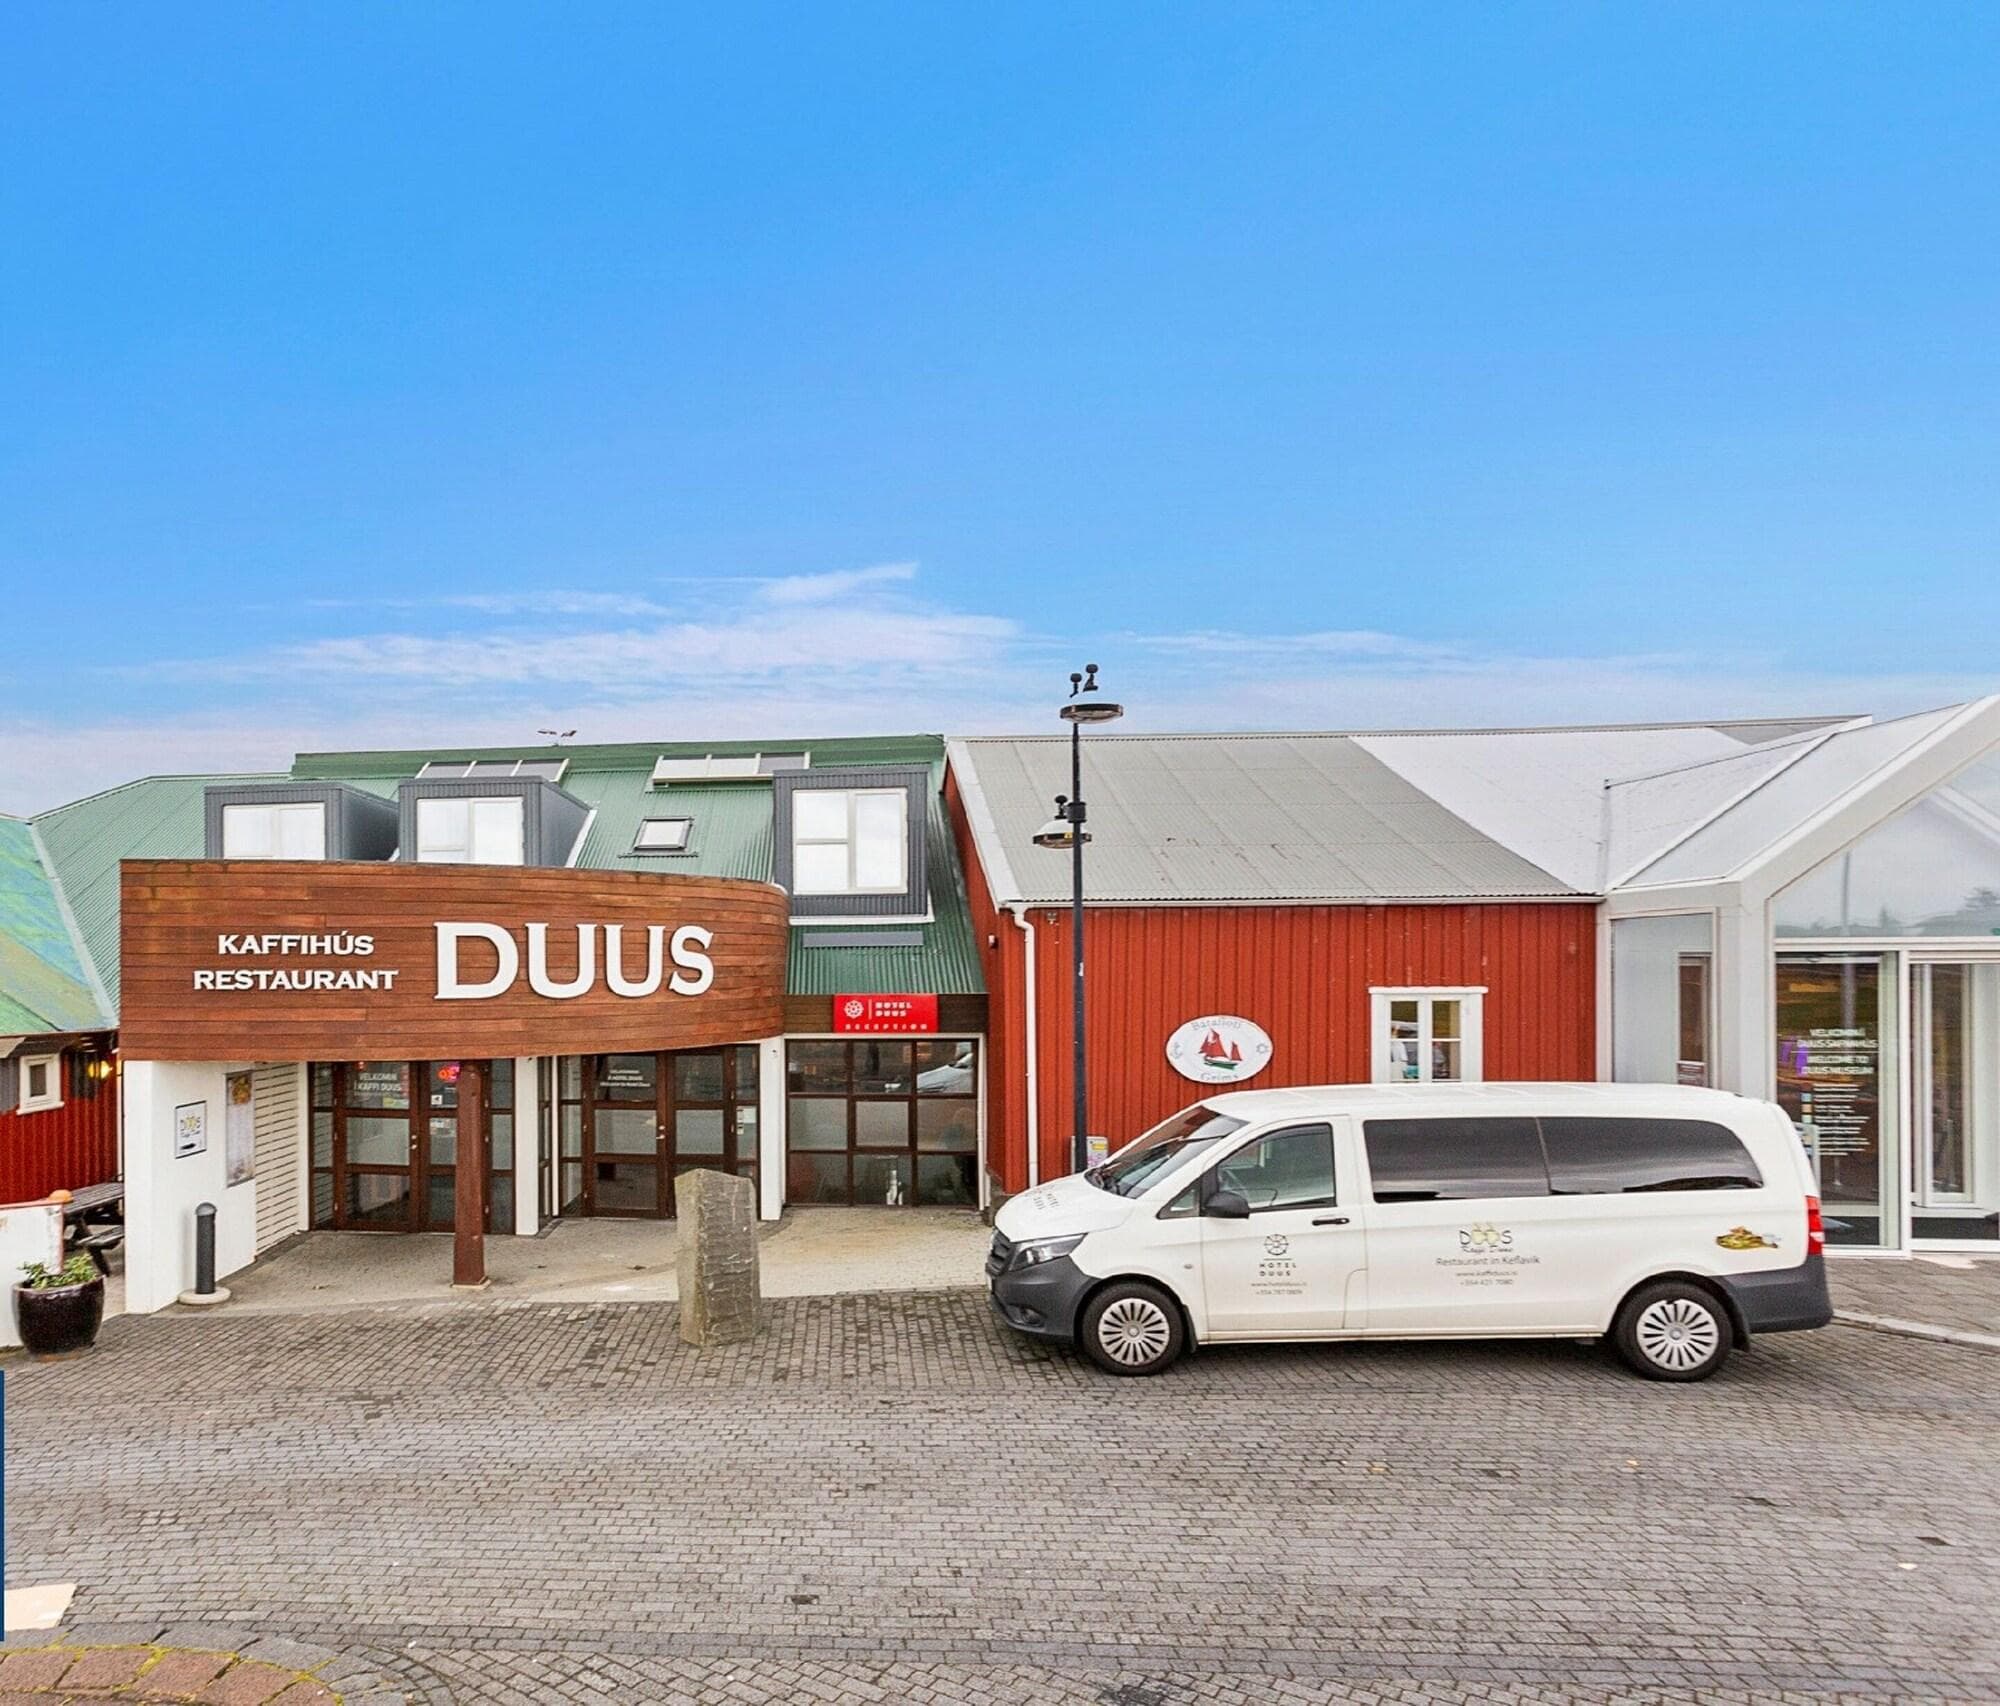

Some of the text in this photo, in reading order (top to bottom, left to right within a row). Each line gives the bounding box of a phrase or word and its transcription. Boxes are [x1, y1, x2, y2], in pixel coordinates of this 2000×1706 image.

[217, 930, 375, 956] KAFFIHÚS
[433, 921, 714, 999] DUUS
[193, 969, 399, 990] RESTAURANT
[875, 1001, 913, 1009] HOTEL
[875, 1010, 907, 1018] DUUS
[845, 1023, 928, 1031] RECEPTION
[1436, 1257, 1489, 1265] Restaurant
